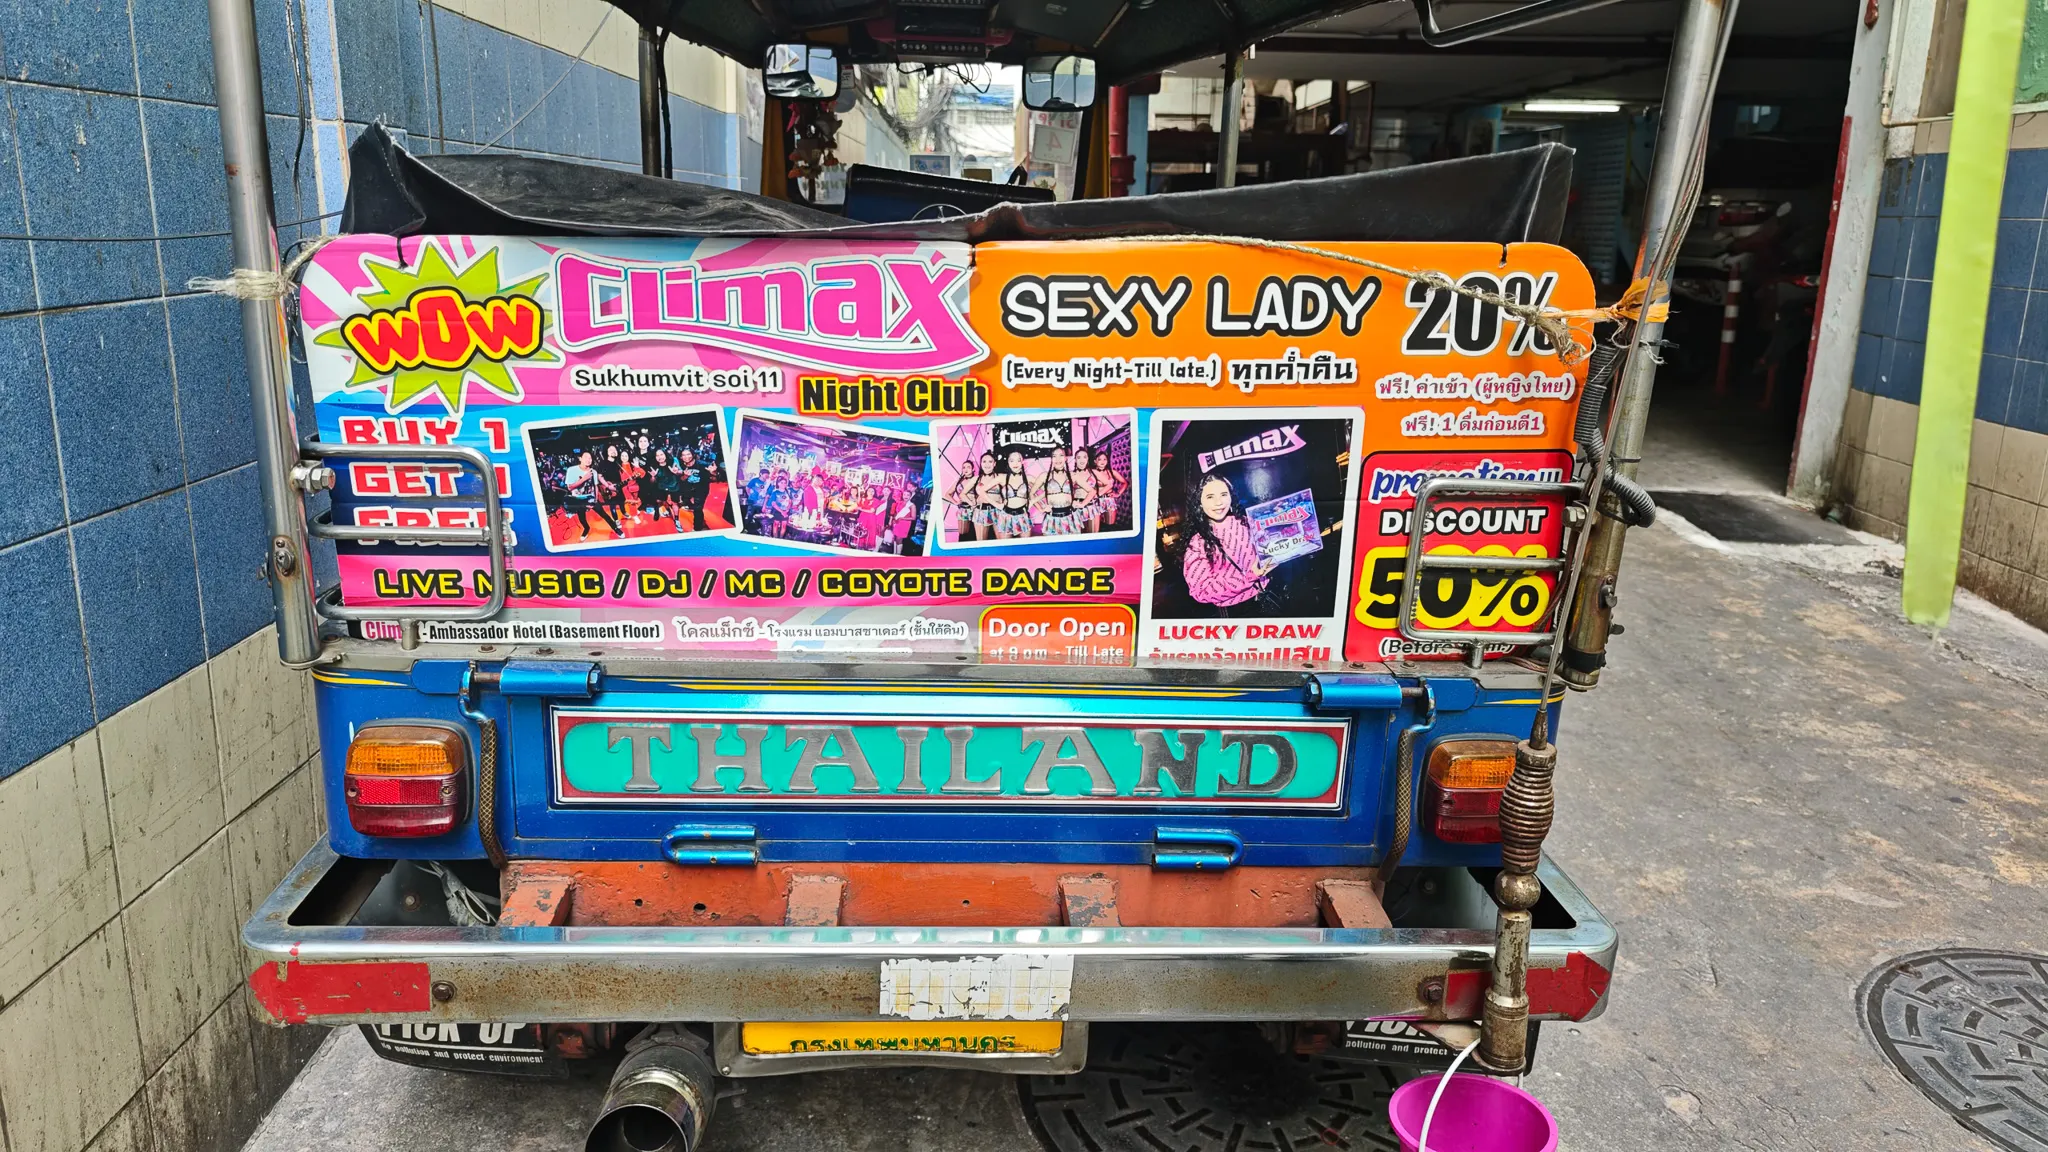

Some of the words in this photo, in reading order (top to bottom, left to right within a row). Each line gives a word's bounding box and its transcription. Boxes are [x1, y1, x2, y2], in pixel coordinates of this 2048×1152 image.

[1004, 280, 1189, 334] SEXY
[1209, 280, 1378, 333] LADY
[1405, 274, 1558, 353] 20%
[575, 369, 703, 388] Sukhumvit
[713, 370, 749, 388] soi
[759, 370, 779, 388] 11
[1006, 359, 1066, 383] (Every
[1073, 360, 1162, 384] Night-Till
[1169, 359, 1217, 381] late.)
[1231, 351, 1353, 388] ทุกค่ำคืน
[801, 378, 899, 416] Night
[905, 378, 988, 413] Club
[1380, 377, 1410, 395] ฟรี!
[1416, 377, 1468, 395] ค่าเข้า
[342, 418, 458, 445] BUY
[483, 420, 506, 450] 1
[1405, 415, 1435, 432] ฟรี!
[1441, 417, 1452, 431] 1
[352, 464, 458, 495] GET
[356, 507, 511, 542] FRE
[1381, 507, 1548, 534] DISCOUNT
[377, 572, 460, 596] LIVE
[476, 572, 601, 596] MUSIC
[642, 573, 689, 595] DJ
[729, 573, 781, 595] MC
[822, 572, 969, 594] COYOTE
[986, 572, 1114, 593] DANCE
[1364, 554, 1542, 620] 50%
[429, 624, 509, 640] Ambassador
[513, 624, 547, 639] Hotel
[549, 623, 621, 640] (Basement
[622, 623, 661, 639] Floor)
[988, 617, 1051, 638] Door
[1059, 617, 1126, 641] Open
[1158, 625, 1240, 641] LUCKY
[1245, 624, 1323, 640] DRAW
[1065, 645, 1088, 657] Till
[1093, 645, 1125, 657] Late
[606, 724, 1300, 797] THAILAND
[789, 1034, 1016, 1053] กรงเทพมหานคร
[1345, 1040, 1387, 1051] pollution
[1391, 1043, 1409, 1053] and
[1414, 1046, 1448, 1056] protect
